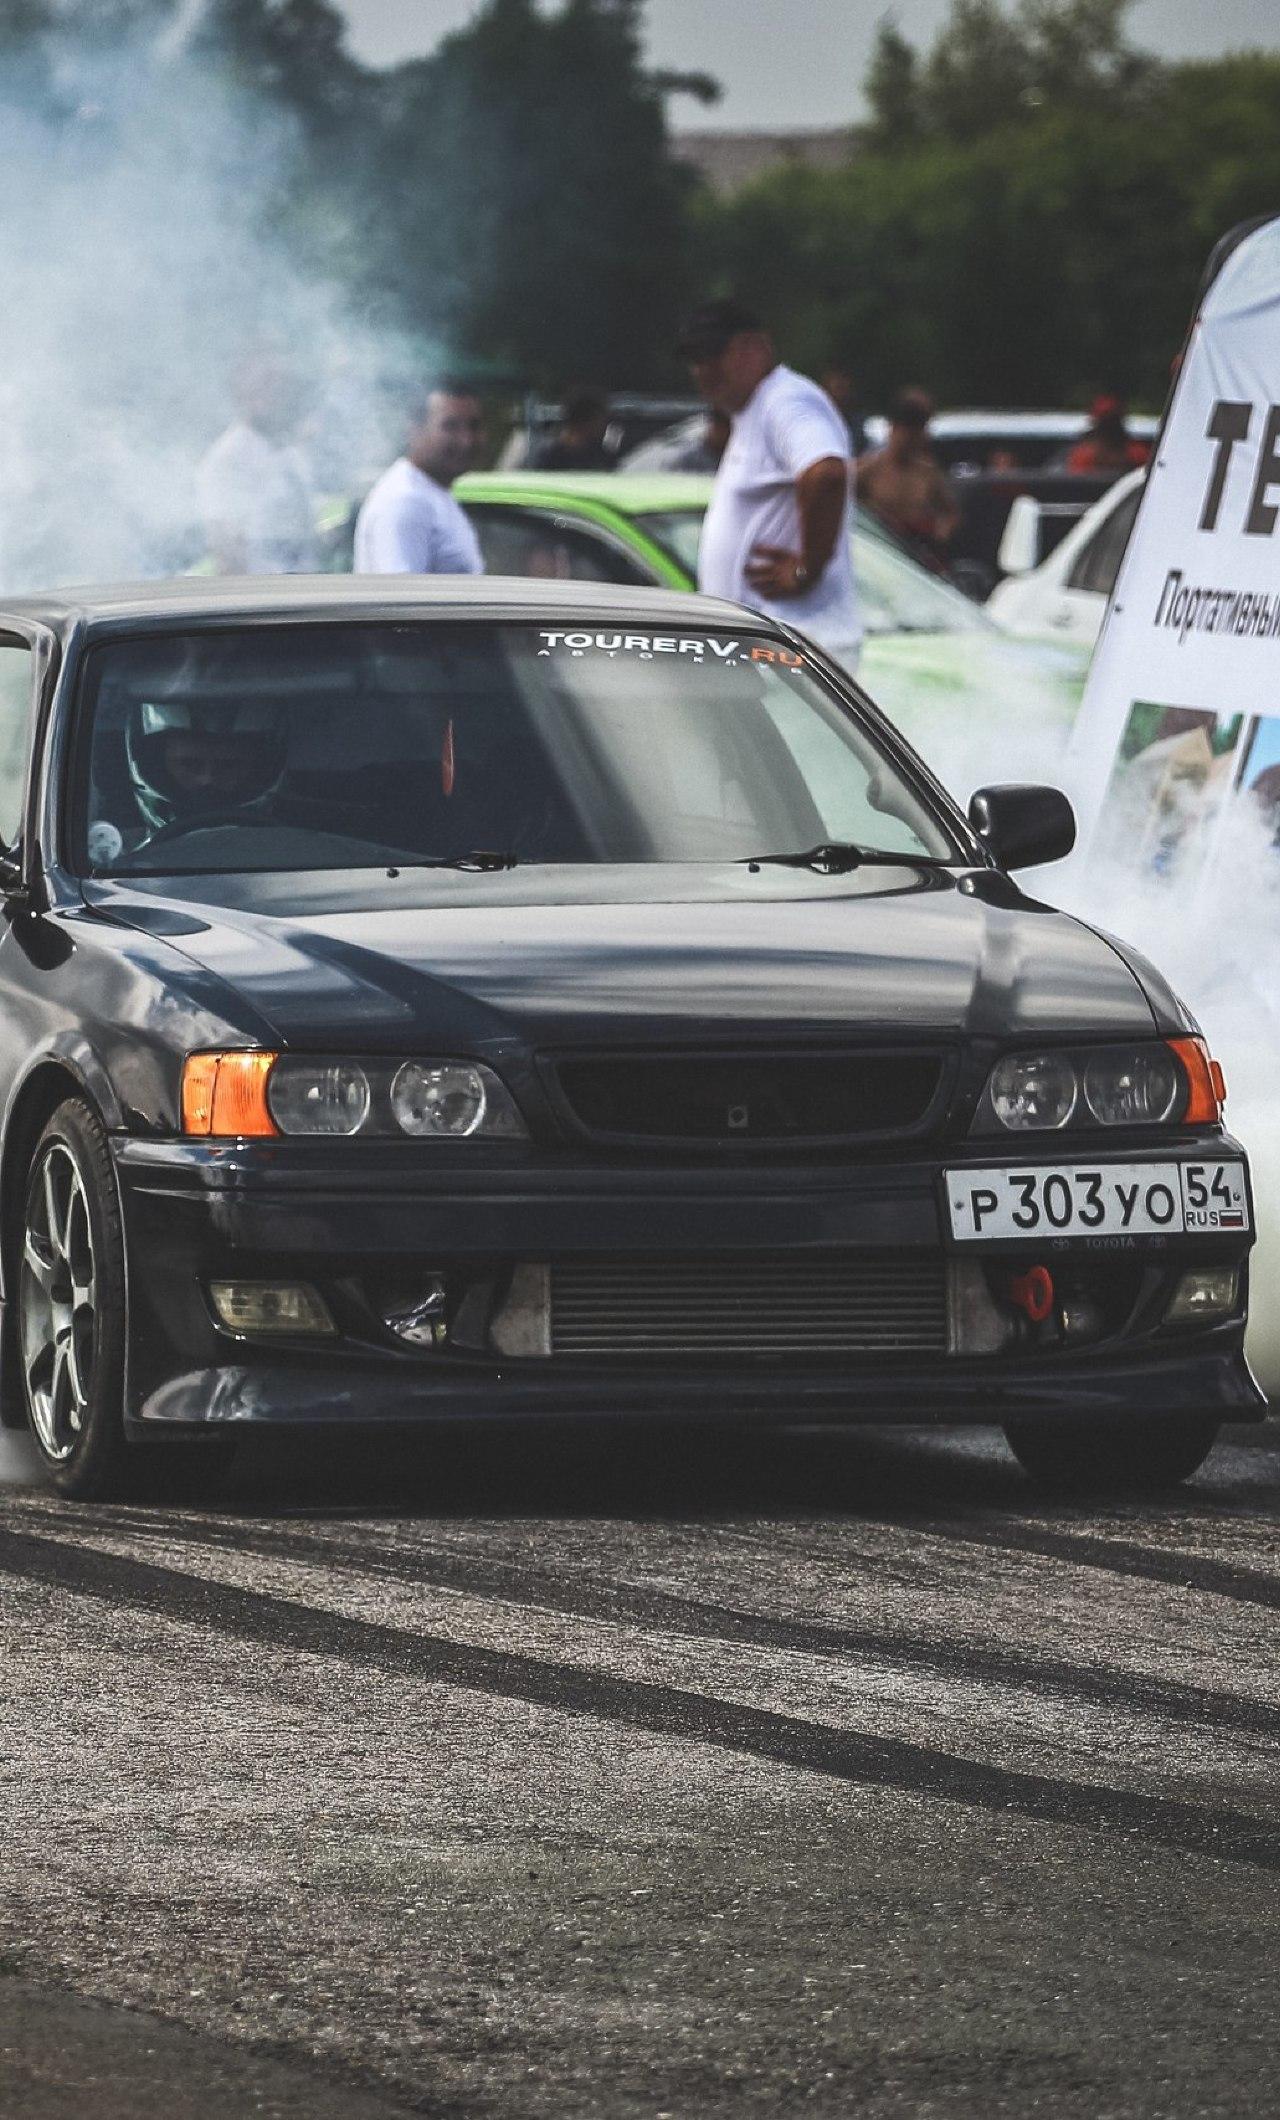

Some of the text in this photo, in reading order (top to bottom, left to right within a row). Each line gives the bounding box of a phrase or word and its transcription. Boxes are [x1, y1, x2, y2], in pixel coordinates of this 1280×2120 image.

[1186, 1166, 1231, 1208] 54
[1185, 1211, 1219, 1226] RUS
[1086, 1236, 1136, 1249] TOYOTA
